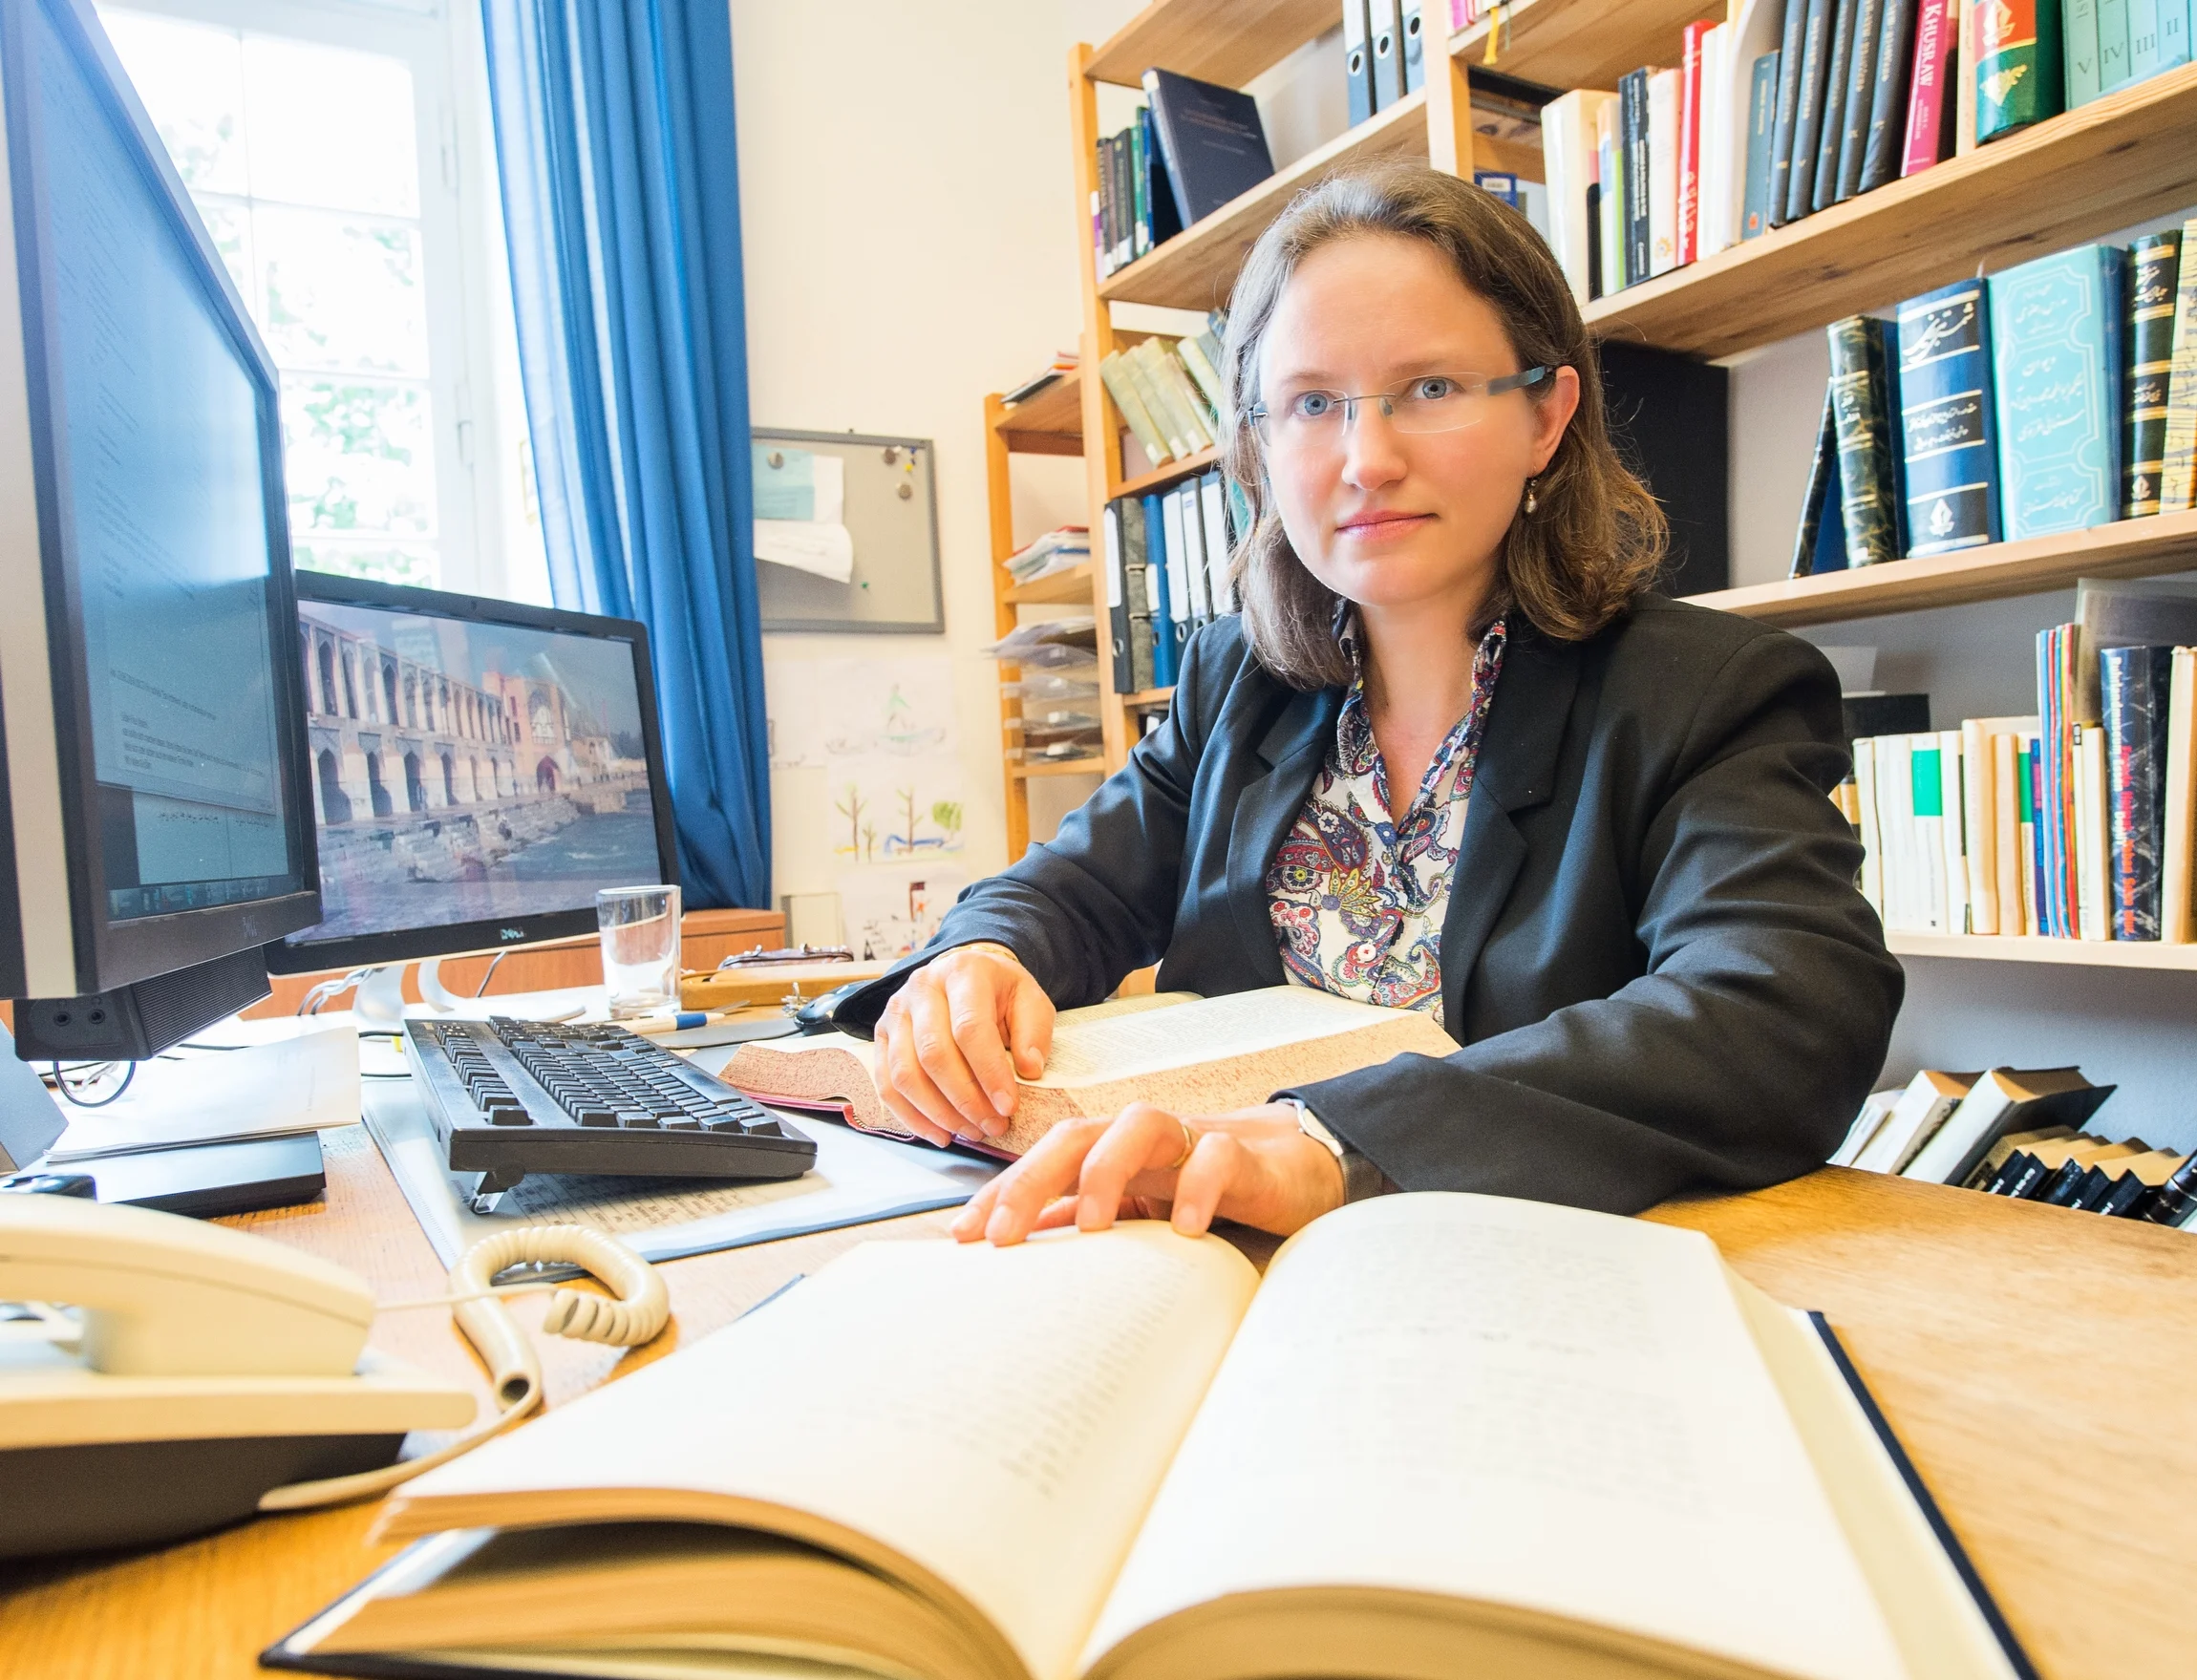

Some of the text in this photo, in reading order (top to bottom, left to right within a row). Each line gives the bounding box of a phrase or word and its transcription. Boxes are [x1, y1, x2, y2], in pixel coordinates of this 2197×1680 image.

[2166, 17, 2179, 36] II
[1920, 3, 1942, 87] KHUSRAW
[2103, 42, 2123, 64] IV
[2136, 33, 2156, 54] III
[2078, 57, 2092, 74] V
